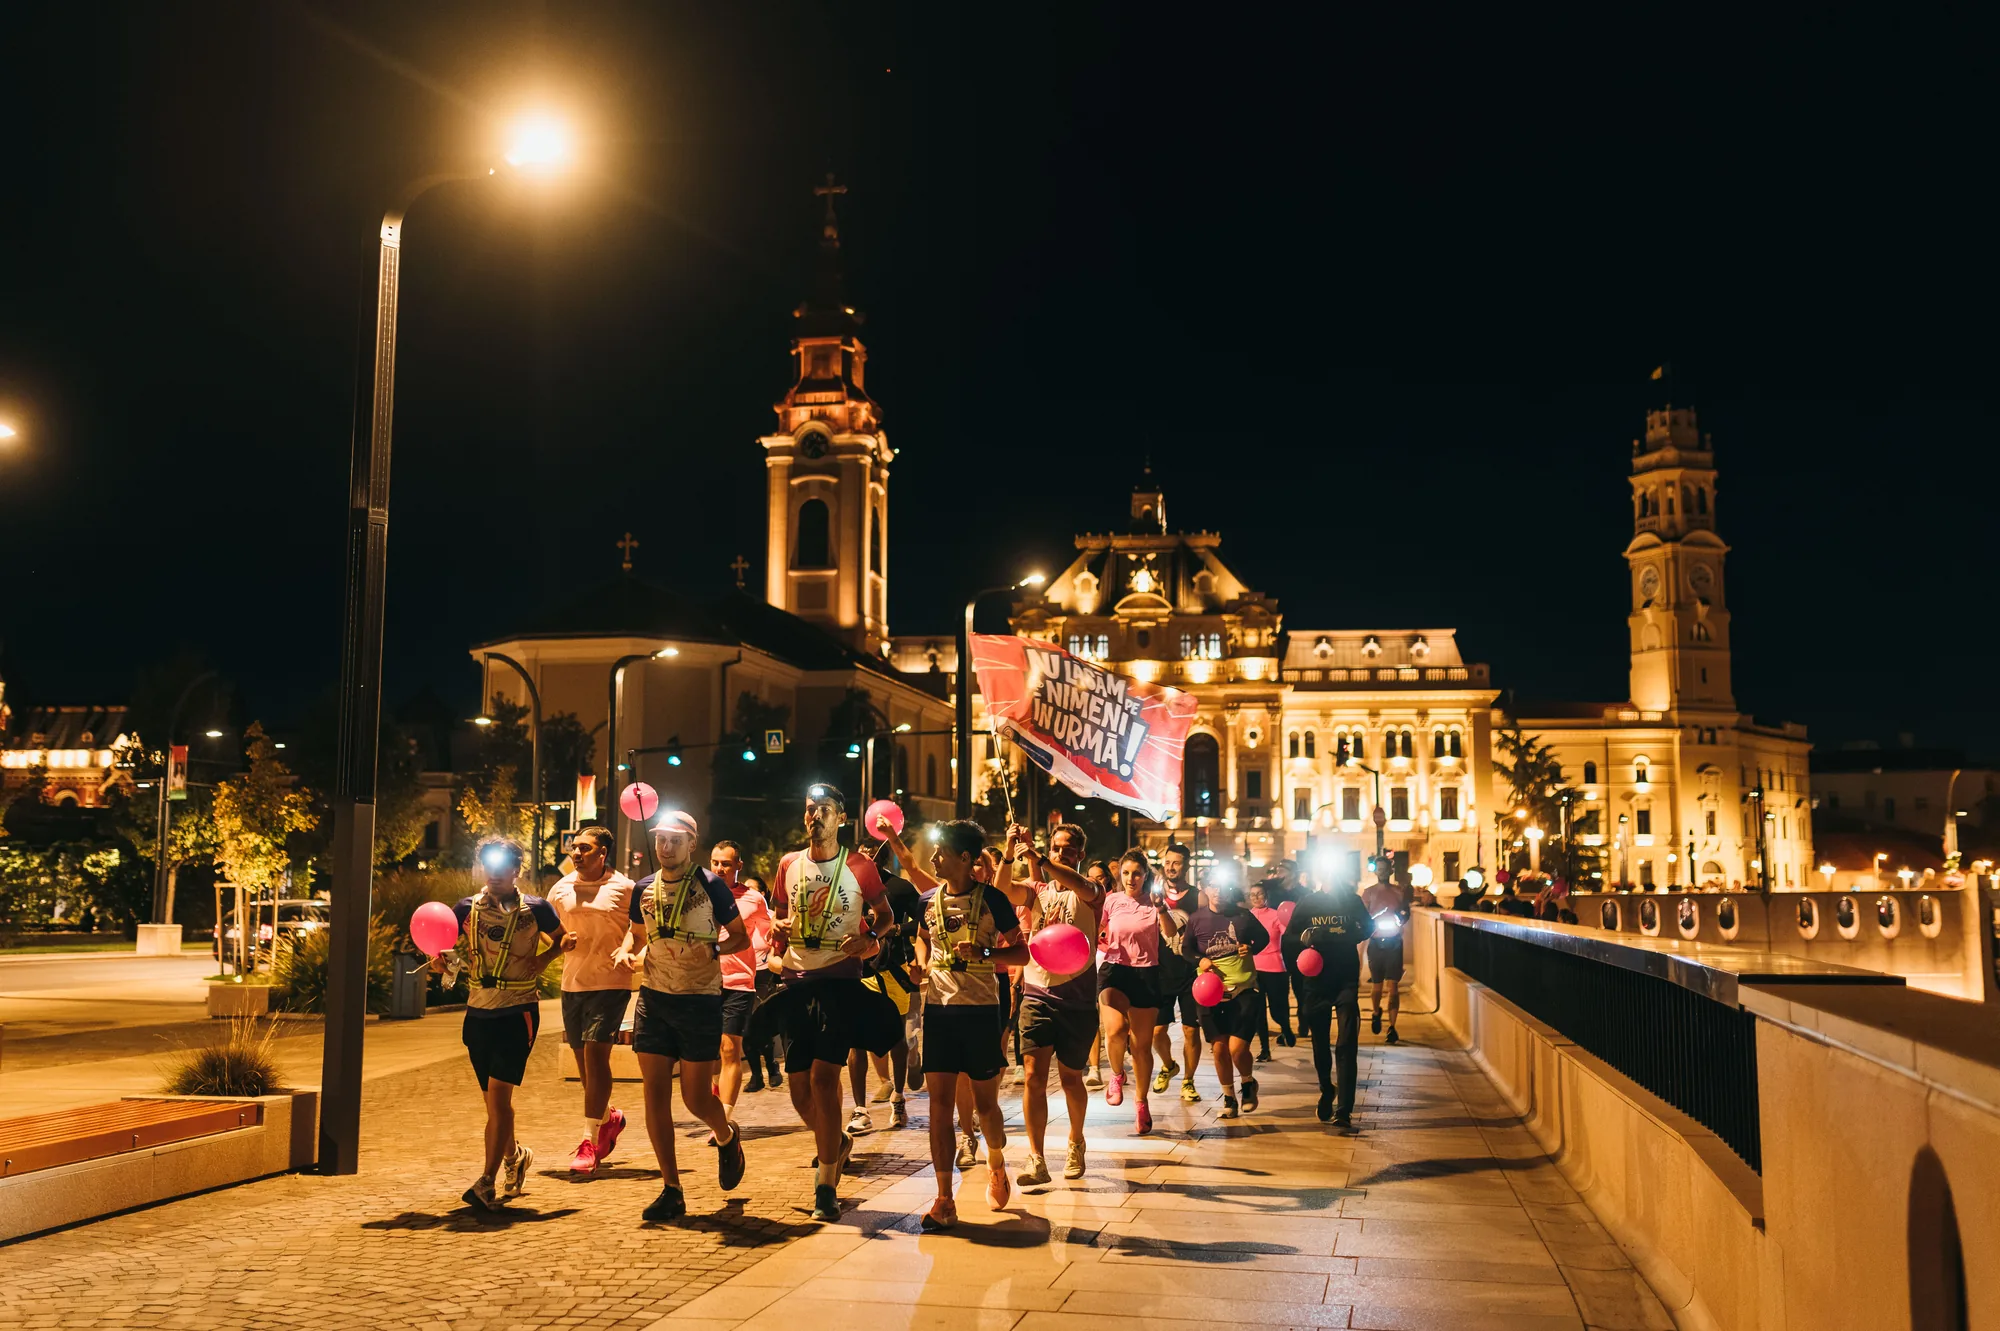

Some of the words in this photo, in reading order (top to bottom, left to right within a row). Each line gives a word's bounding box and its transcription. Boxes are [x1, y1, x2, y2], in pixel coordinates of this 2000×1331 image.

[1027, 648, 1060, 683] NU
[1124, 698, 1141, 716] PE
[1045, 679, 1129, 736] NIMENI
[790, 875, 811, 913] ORADA
